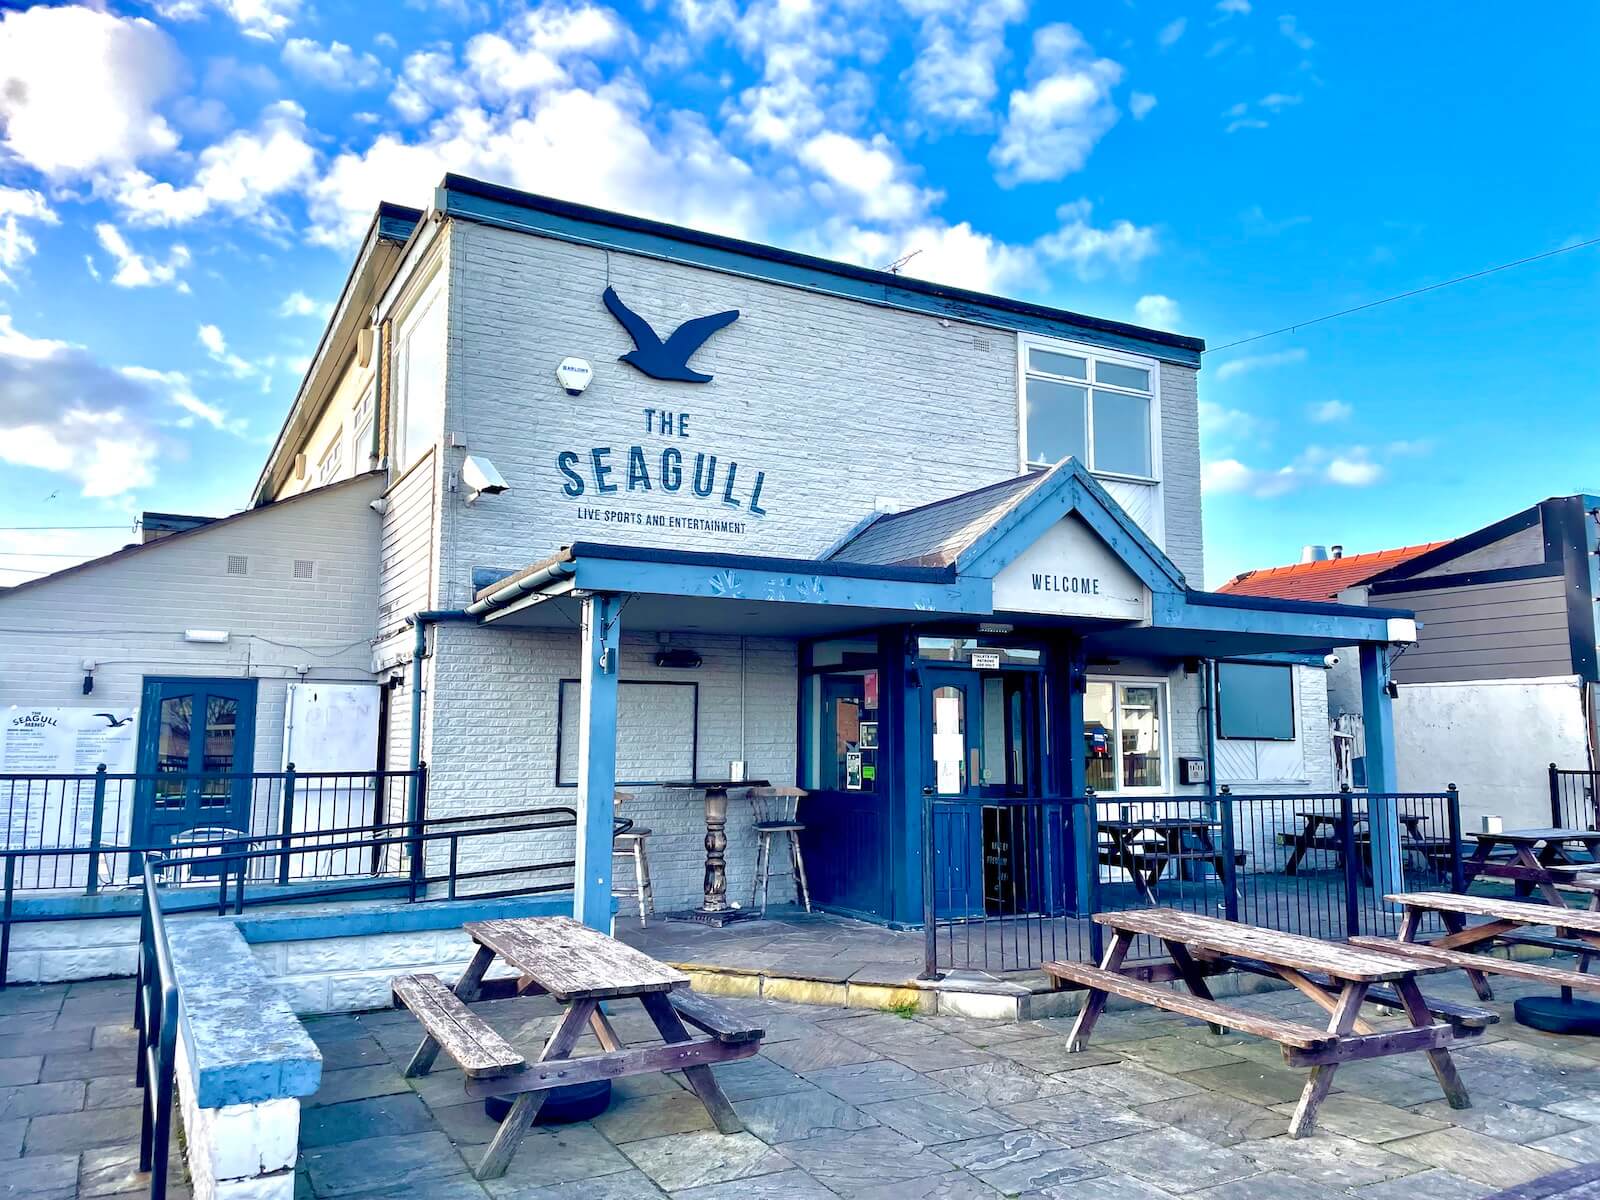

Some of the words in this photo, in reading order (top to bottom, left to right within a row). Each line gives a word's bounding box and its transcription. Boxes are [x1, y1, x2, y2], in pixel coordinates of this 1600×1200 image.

[645, 408, 690, 438] THE
[557, 446, 767, 516] SEAGULL
[577, 507, 601, 521] LIVE
[604, 510, 642, 525] SPORTS
[646, 514, 665, 527] AND
[668, 516, 746, 534] ENTERTAINMENT
[1032, 573, 1099, 595] WELCOME
[12, 715, 58, 726] SEAGULL
